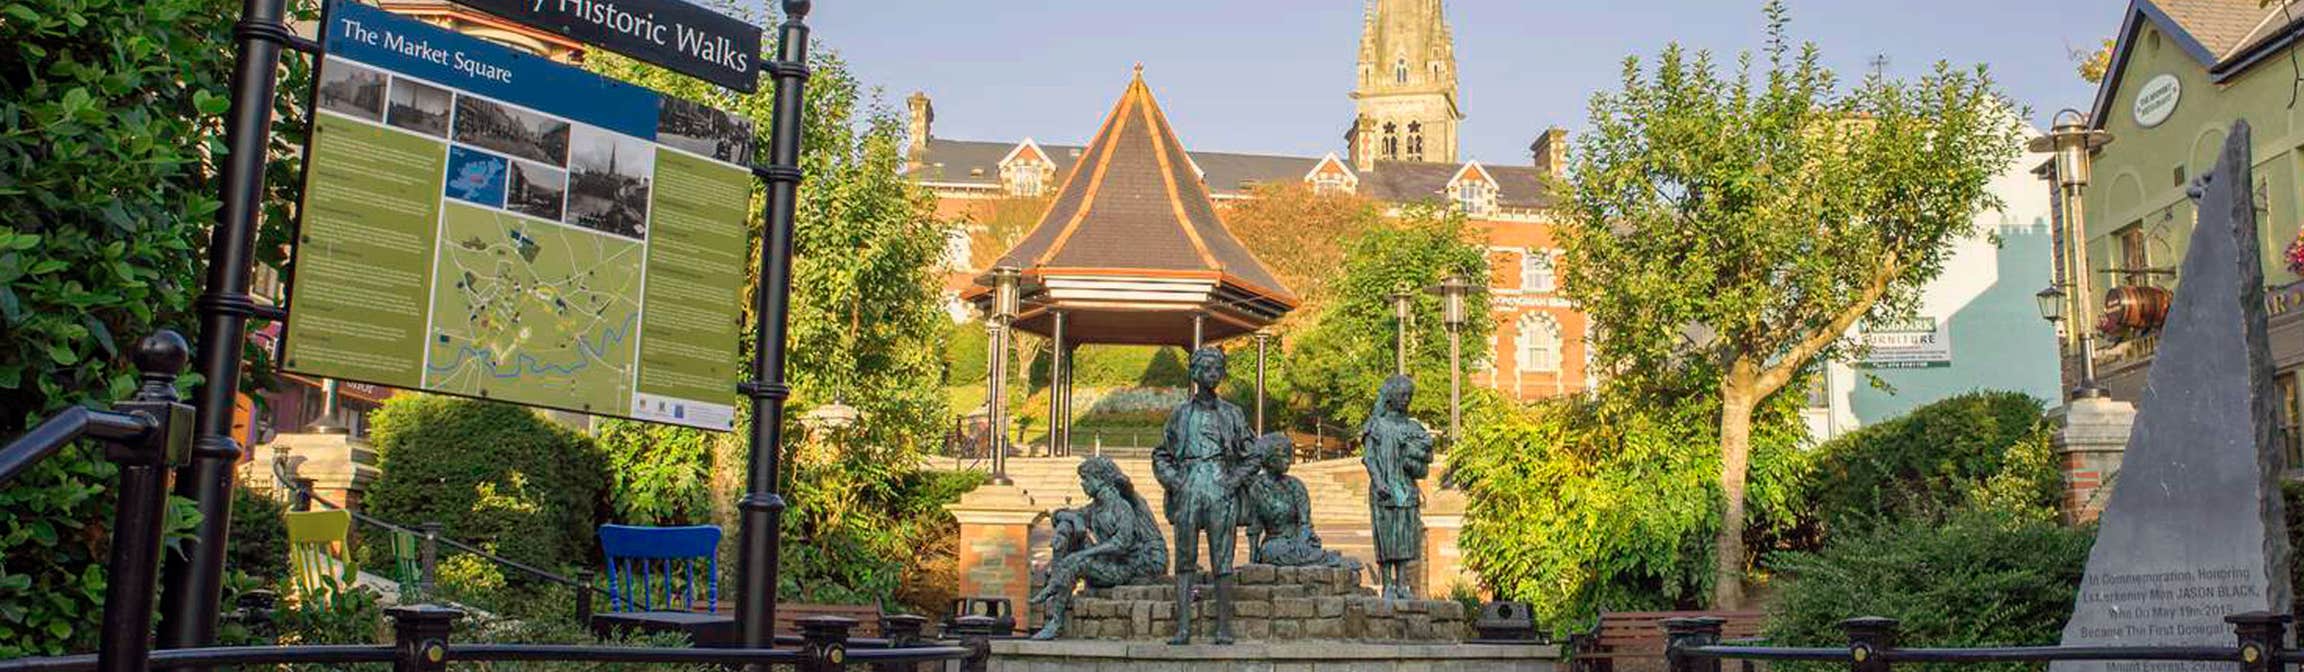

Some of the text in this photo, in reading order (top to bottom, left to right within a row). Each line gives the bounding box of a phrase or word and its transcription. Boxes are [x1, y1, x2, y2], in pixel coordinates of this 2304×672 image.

[559, 0, 748, 73] Historic Walks
[341, 18, 512, 84] The Market Square
[2176, 586, 2215, 600] JASON
[2153, 605, 2175, 619] May
[2080, 626, 2122, 639] Became
[2126, 624, 2146, 636] The
[2149, 624, 2175, 636] First
[2177, 623, 2223, 637] Donegal
